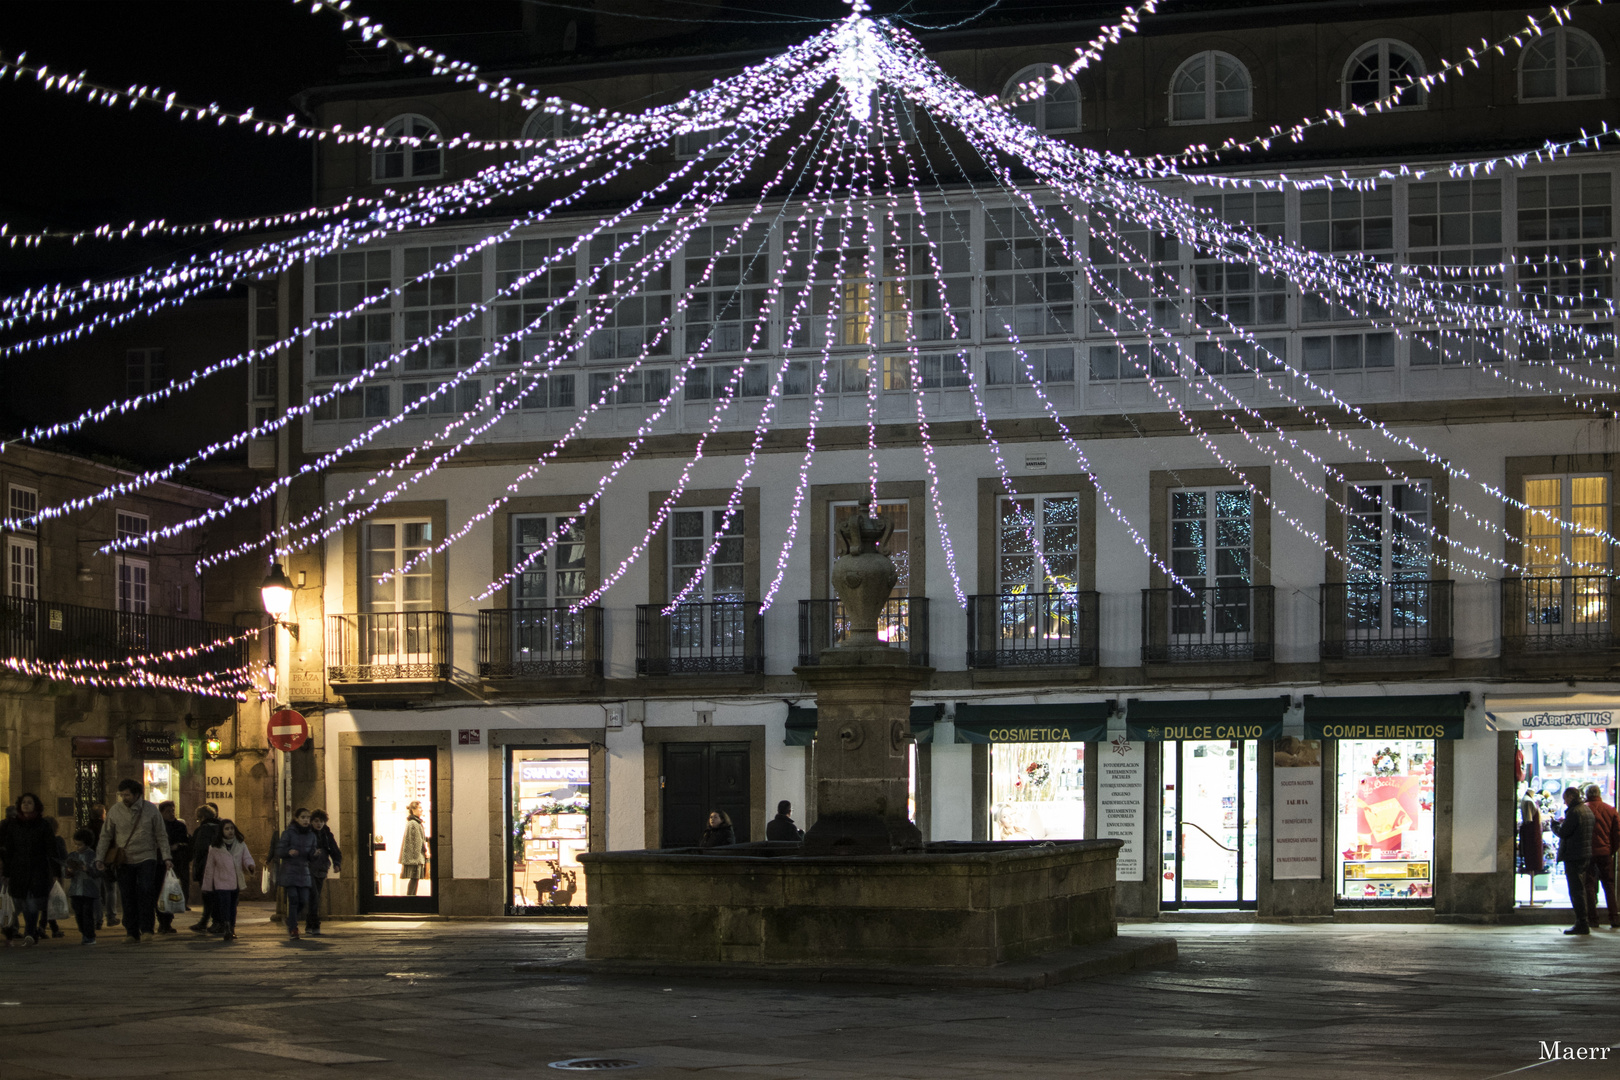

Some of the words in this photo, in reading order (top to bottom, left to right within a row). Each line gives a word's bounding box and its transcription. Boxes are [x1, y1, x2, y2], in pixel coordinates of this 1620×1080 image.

[703, 714, 706, 724] 1
[1522, 718, 1535, 726] LA
[1535, 712, 1578, 726] FÁBRICA
[1580, 712, 1612, 726] NIKIS
[989, 728, 1071, 741] COSMETICA
[1164, 726, 1212, 739] DULCE
[1216, 725, 1263, 738] CALVO
[1323, 724, 1444, 737] COMPLEMENTOS
[207, 776, 233, 785] IOLA
